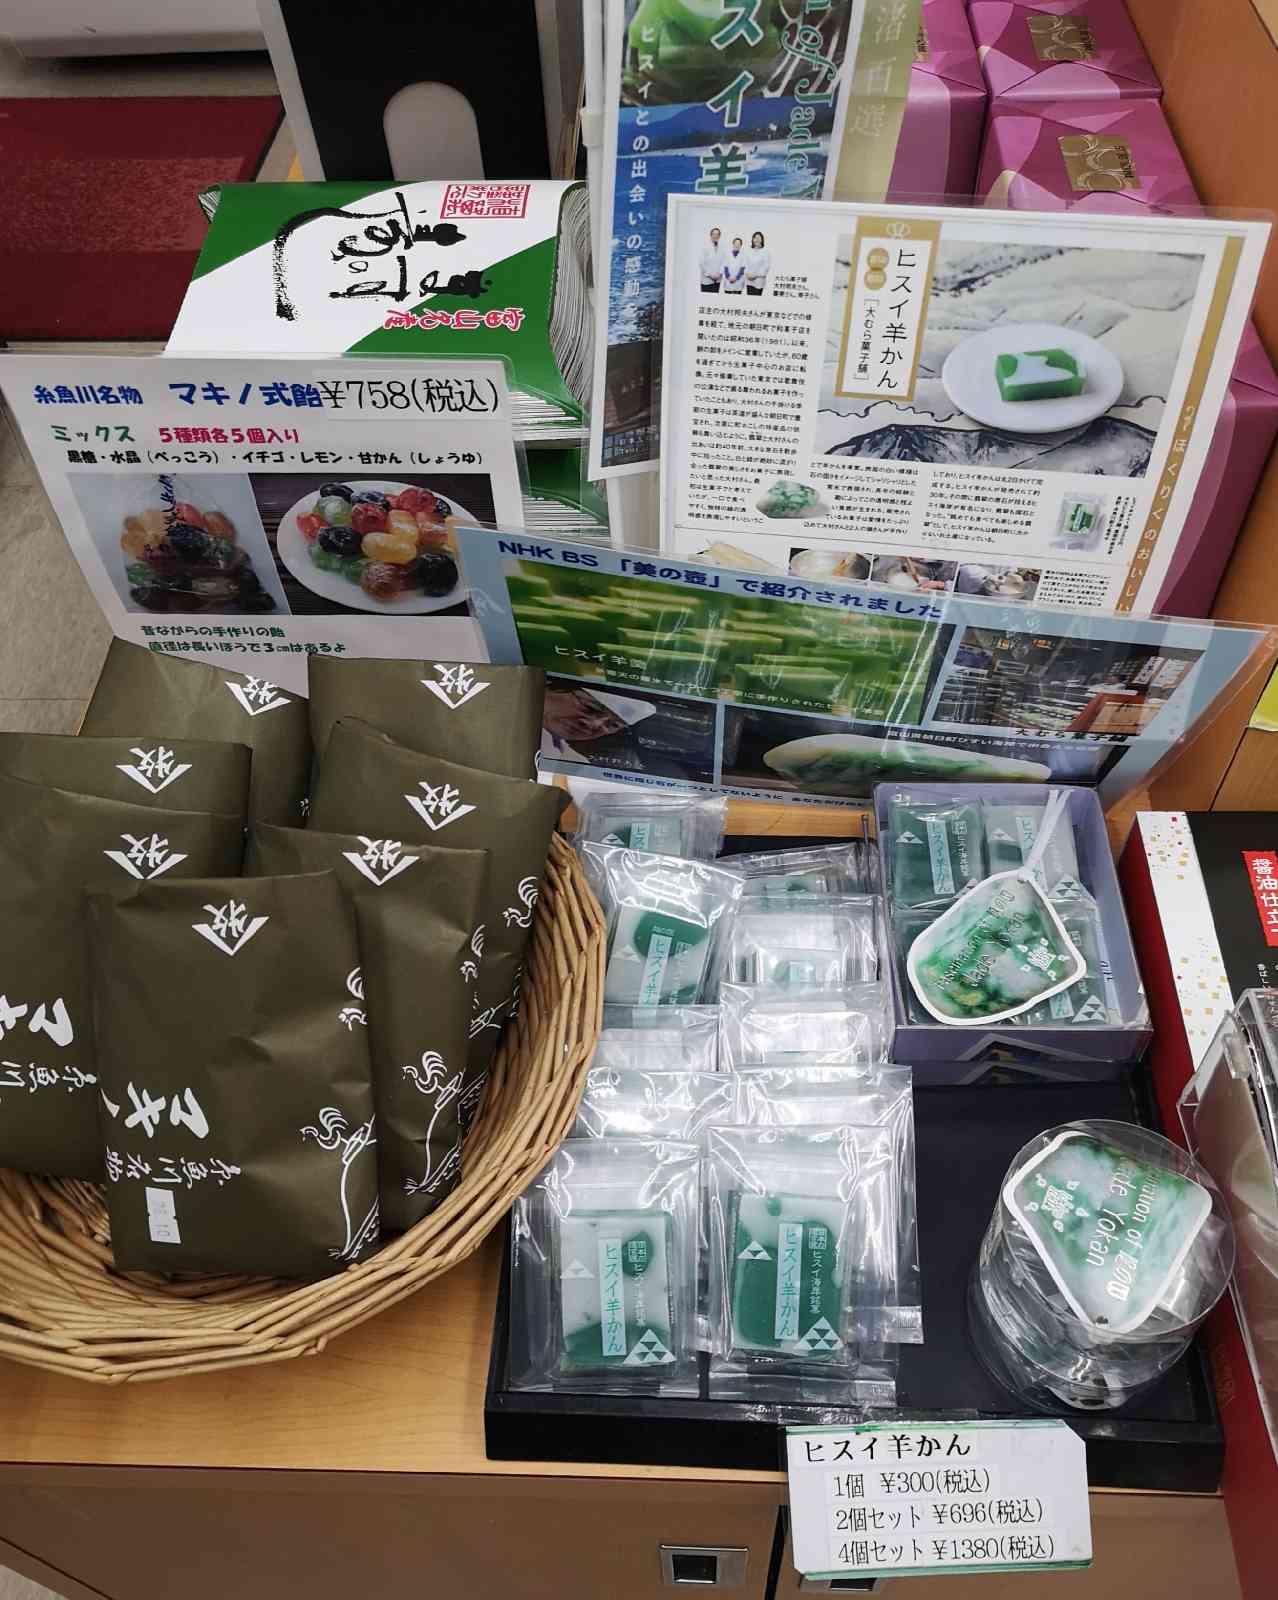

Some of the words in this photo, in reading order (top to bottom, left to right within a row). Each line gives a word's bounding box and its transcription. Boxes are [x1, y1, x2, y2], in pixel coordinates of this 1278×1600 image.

[783, 77, 836, 173] Jade
[876, 247, 917, 390] ヒスイ羊かん
[34, 384, 144, 406] 糸魚川名物
[169, 382, 323, 408] マキノ式飴
[317, 377, 499, 413] ¥758(税込)
[51, 425, 135, 443] ミックス
[160, 426, 300, 444] 5種類各5個入り
[498, 540, 554, 561] NHK
[562, 550, 599, 569] BS
[736, 577, 946, 620] で紹介されました
[141, 625, 286, 639] 昔ながらの手作りの飴
[1086, 1207, 1130, 1267] Yokan
[602, 1244, 625, 1354] ヒスイ羊かん
[779, 1230, 801, 1338] ヒスイ羊かん
[805, 1433, 971, 1463] ヒスイ羊かん
[833, 1473, 866, 1499] 1個
[880, 1468, 991, 1495] ¥300(税込)
[836, 1505, 922, 1533] 2個セット
[932, 1497, 1043, 1525] ¥696(税込)
[838, 1538, 924, 1566] 4個セット
[932, 1535, 1056, 1561] ¥1380(税込)
